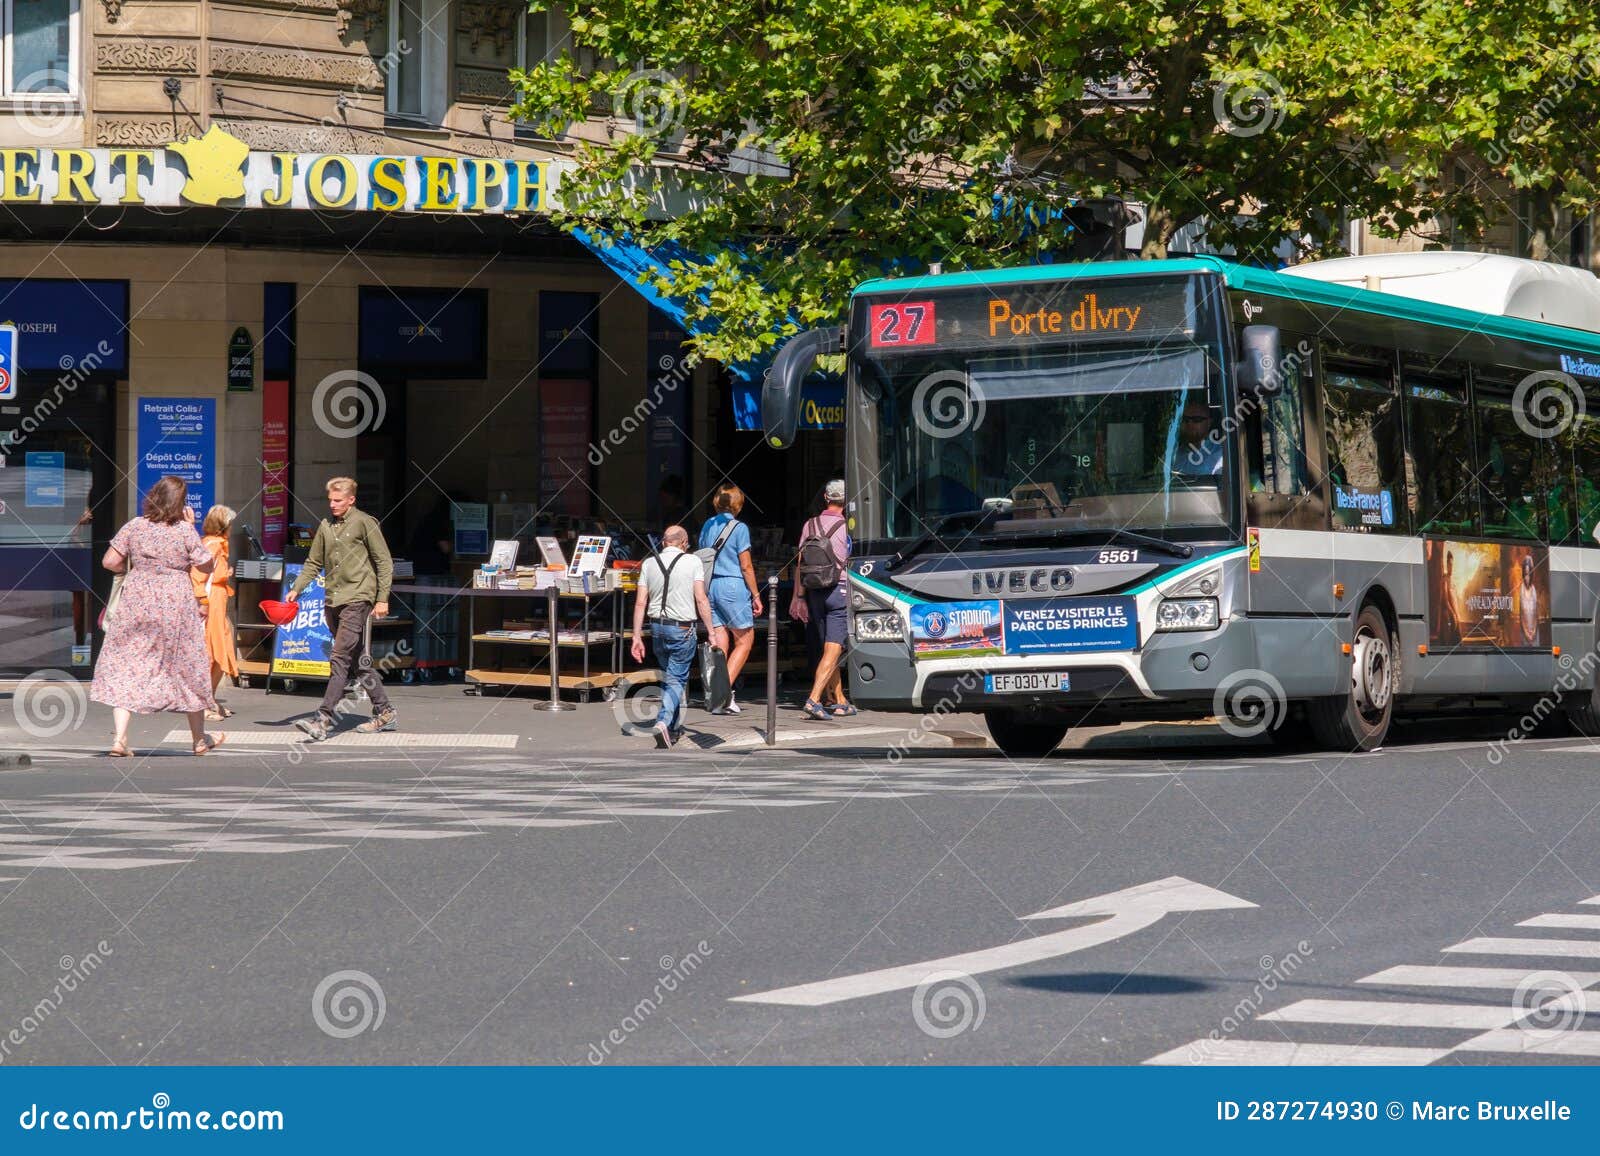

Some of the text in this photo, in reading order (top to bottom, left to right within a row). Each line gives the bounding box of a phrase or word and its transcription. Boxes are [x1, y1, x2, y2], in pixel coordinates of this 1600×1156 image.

[263, 152, 551, 212] JOSEPH
[987, 294, 1142, 336] Porte d'Ivry
[879, 306, 926, 342] 27
[144, 404, 174, 413] Retrait
[176, 404, 198, 413] Colis
[146, 453, 172, 464] Dépôt
[175, 453, 196, 462] Colis
[1098, 549, 1139, 564] 5561
[971, 568, 1075, 594] IVECO
[949, 609, 992, 626] STADIUM
[1015, 606, 1124, 621] VENEZ VISITER LE
[1011, 617, 1129, 632] PARC DES PRINCES
